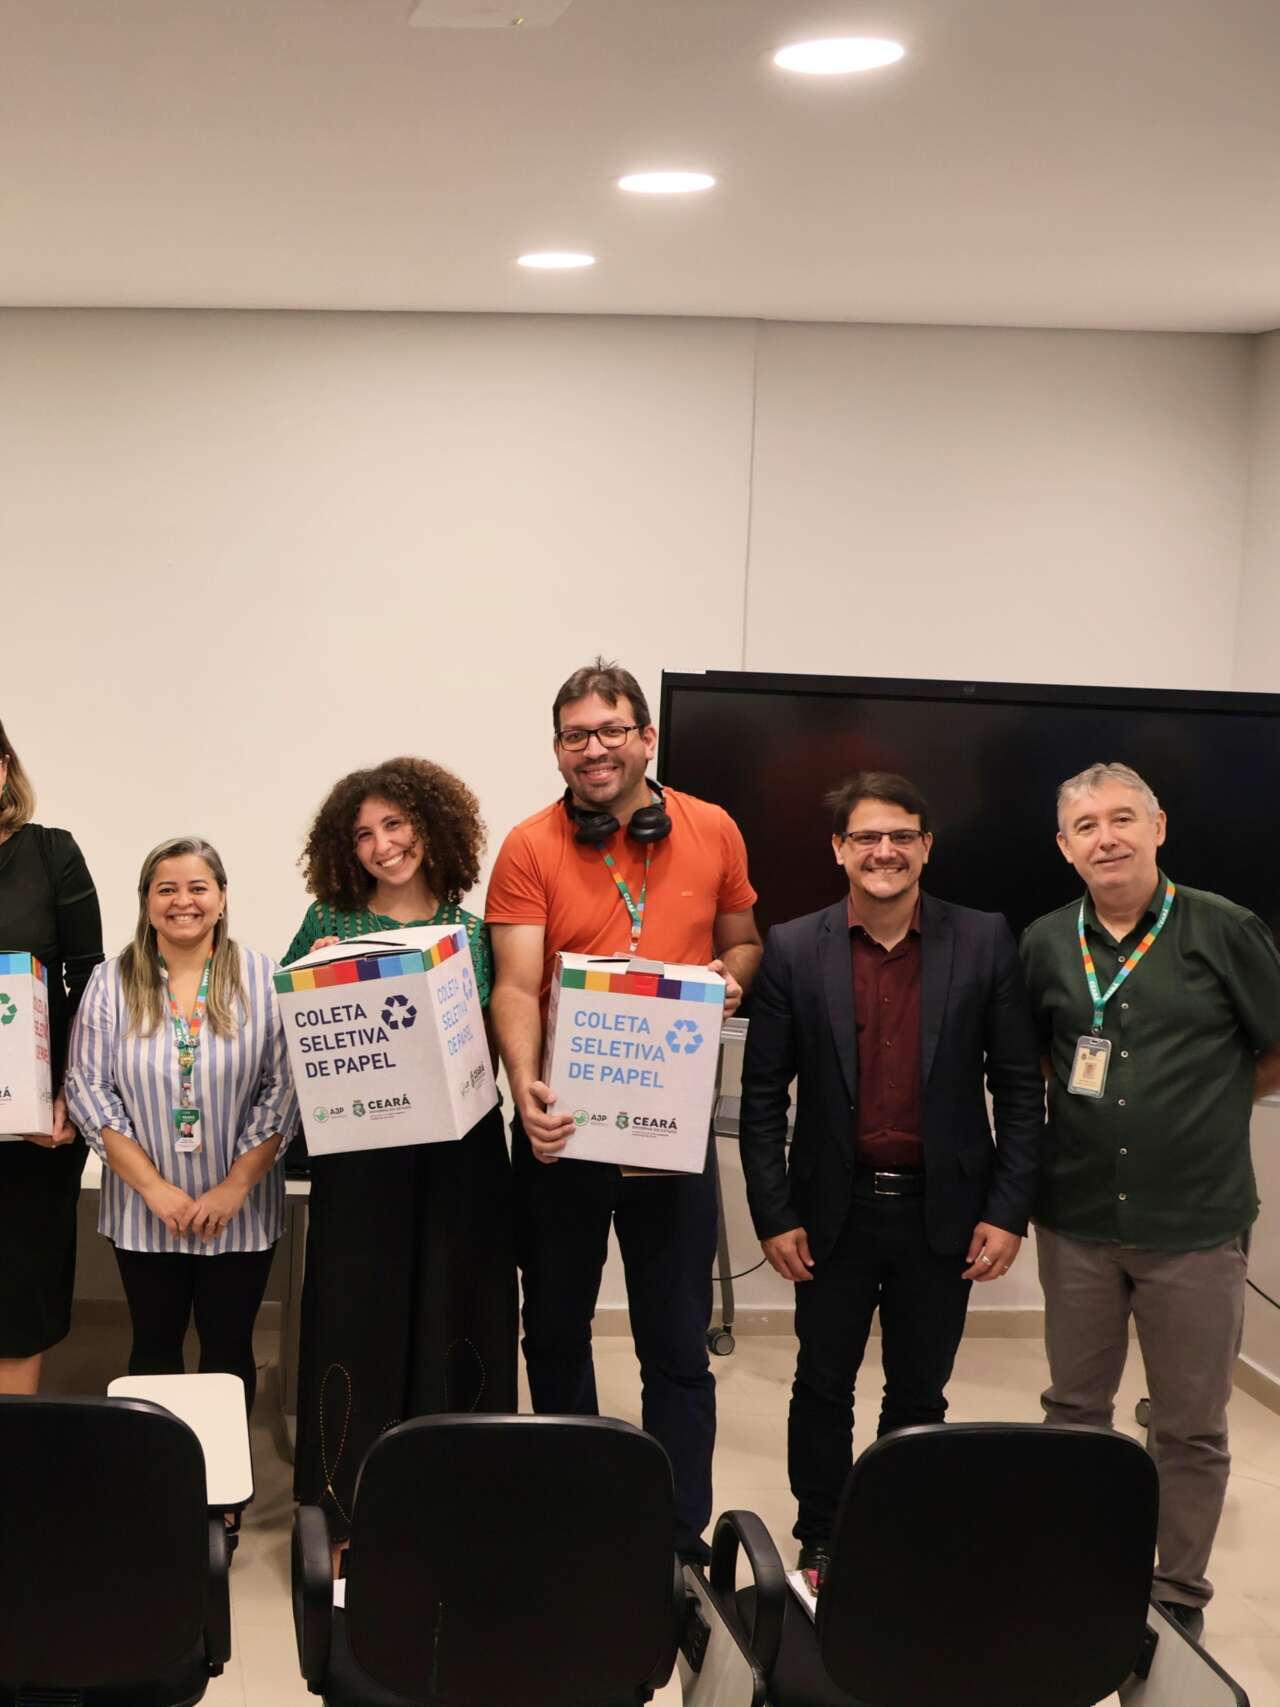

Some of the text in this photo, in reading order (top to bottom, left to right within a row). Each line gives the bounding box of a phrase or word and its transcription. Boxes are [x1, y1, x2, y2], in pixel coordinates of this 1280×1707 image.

[295, 1003, 367, 1028] COLETA
[575, 1010, 650, 1034] COLETA
[300, 1026, 389, 1053] SELETIVA
[570, 1036, 665, 1062] SELETIVA
[305, 1052, 396, 1078] DE PAPEL
[568, 1063, 664, 1088] DE PAPEL
[368, 1094, 411, 1110] CEARÁ
[633, 1117, 677, 1129] CEARÁ
